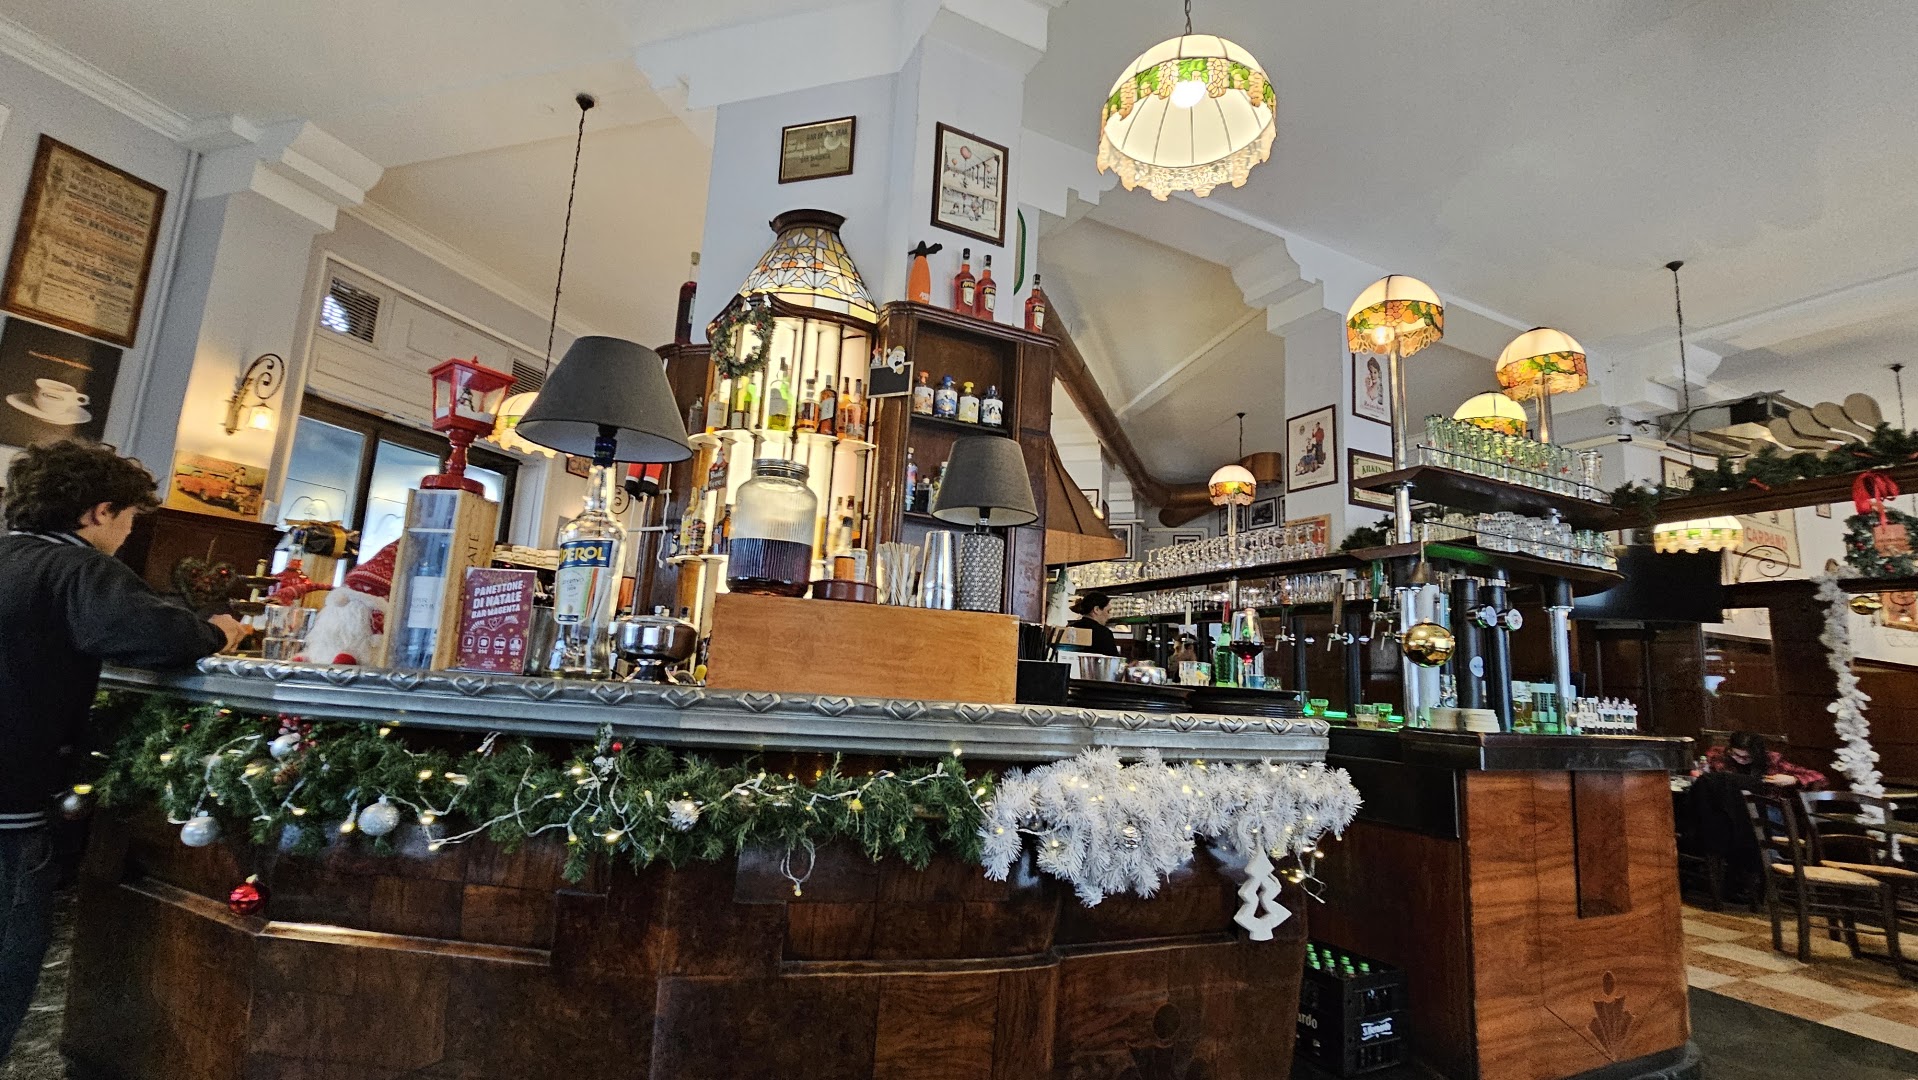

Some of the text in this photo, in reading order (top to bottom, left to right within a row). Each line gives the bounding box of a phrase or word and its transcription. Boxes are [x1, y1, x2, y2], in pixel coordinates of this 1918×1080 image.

[1361, 464, 1388, 475] KILKEN
[474, 580, 524, 597] PANETTONE
[472, 591, 522, 610] DI NATALE
[471, 604, 521, 619] BAR MAGENTA
